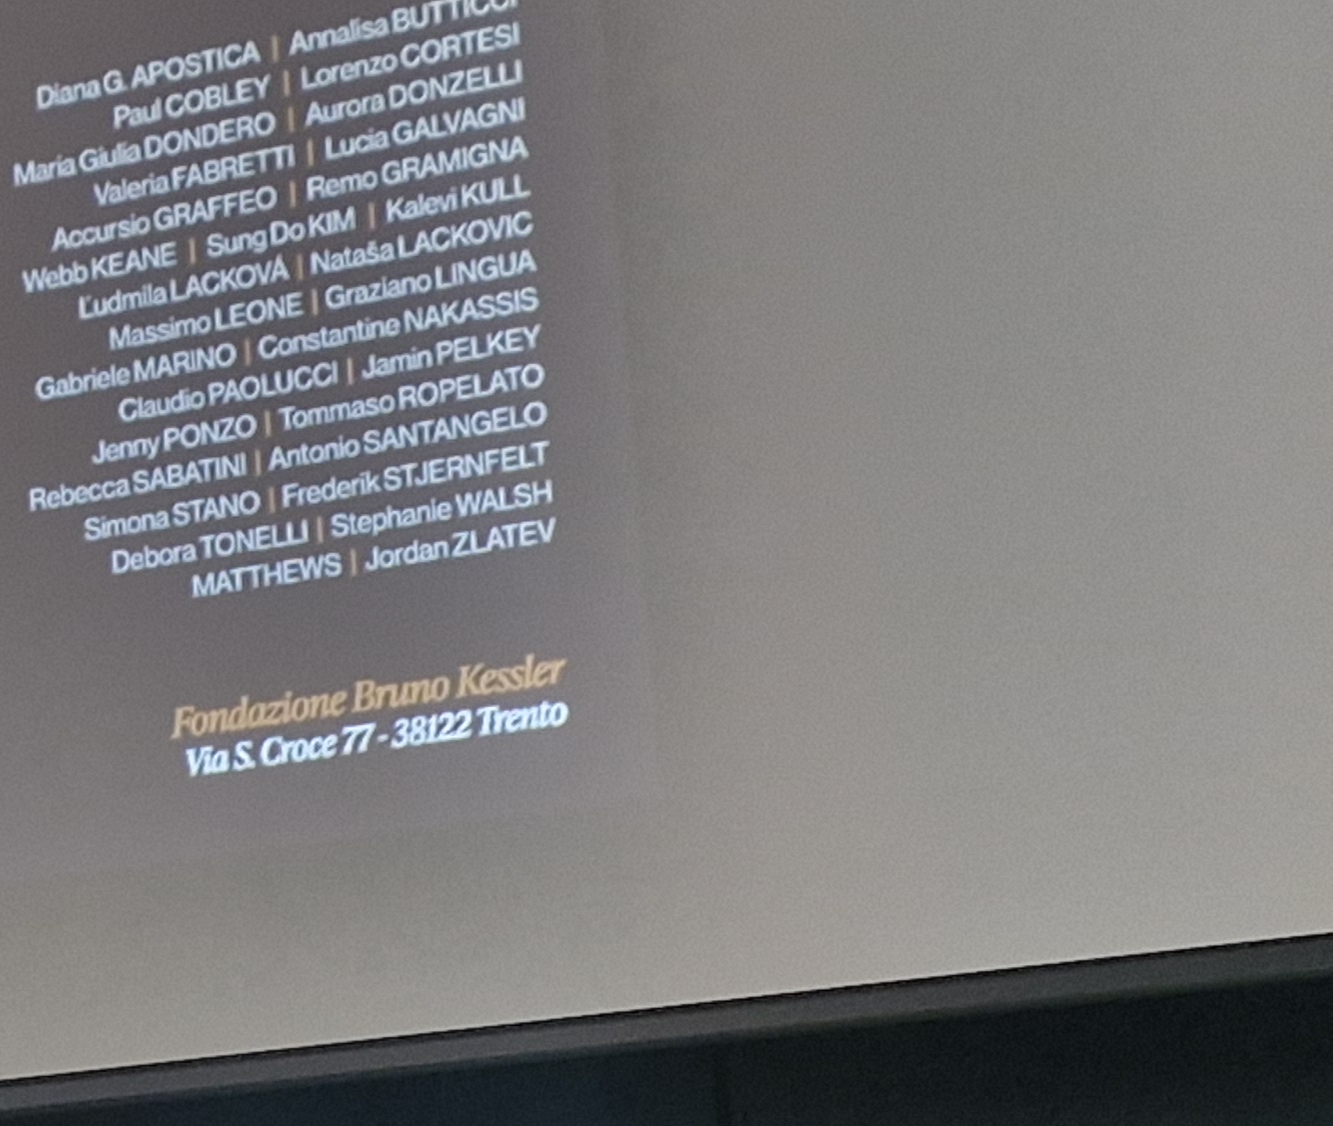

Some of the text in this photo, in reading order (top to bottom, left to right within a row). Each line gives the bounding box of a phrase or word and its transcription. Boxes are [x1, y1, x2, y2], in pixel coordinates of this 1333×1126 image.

[36, 79, 102, 111] Diana
[102, 69, 128, 95] G.
[130, 40, 261, 90] APOSTICA
[288, 17, 391, 56] Annalisa
[113, 22, 520, 129] Paul COBLEY Lorenzo CORTESI
[13, 59, 523, 187] Maria Giulia DONDERO Aurora DONZELLI
[93, 96, 526, 206] Valeria FABRETTI Lucia GALVAGNI
[21, 174, 531, 293] Webb KEANE Sung Do KIM Kalevi KULL
[51, 135, 529, 252] Accursio GRAFFEO Remo GRAMIGNA
[109, 249, 538, 351] Massimo LEONE Graziano LINGUA
[310, 241, 395, 275] Nataša
[34, 286, 540, 401] Gabriele MARINO Constantine NAKASSIS
[117, 324, 541, 423] Claudio PAOLUCCI Jamin PELKEY
[28, 401, 548, 512] Rebecca SABATINI Antonio SANTANGELO
[91, 363, 545, 465] Jenny PONZO Tommaso ROPELATO
[83, 440, 550, 542] Simona STANO Frederik STJERNFELT
[111, 479, 553, 575] Debora TONELLI Stephanie WALSH
[191, 517, 556, 598] MATTHEWS Jordan ZLATEV
[171, 653, 566, 739] Fondazione Bruno Kessler
[185, 700, 569, 777] Via S. Croce 77 38122 Trento
